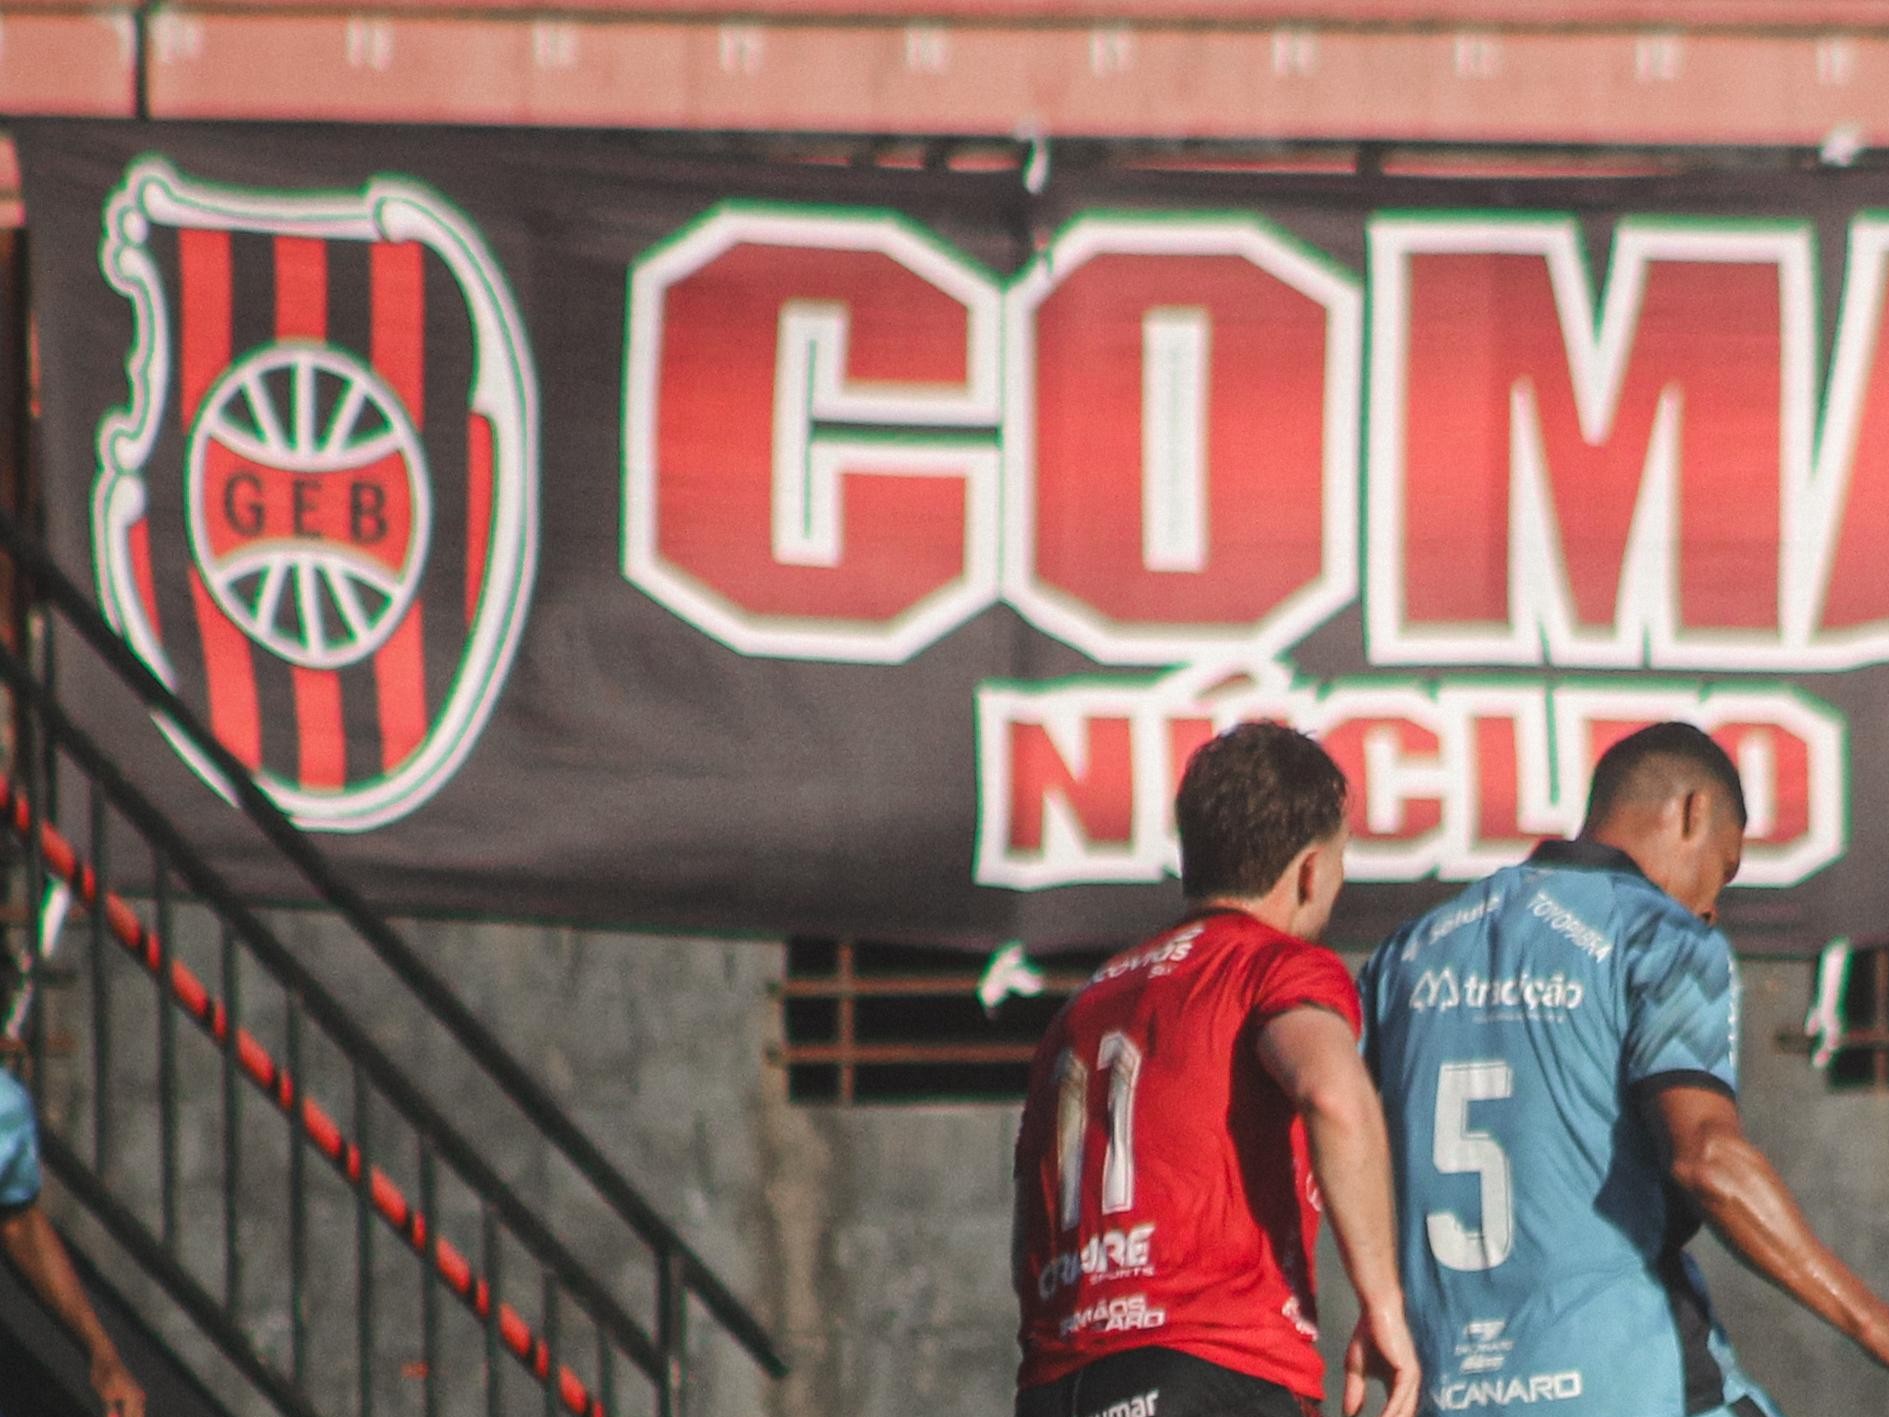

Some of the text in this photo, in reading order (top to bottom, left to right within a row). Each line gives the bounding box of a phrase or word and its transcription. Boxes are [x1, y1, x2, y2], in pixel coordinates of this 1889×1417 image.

[976, 660, 1850, 888] NCLO
[1053, 1030, 1142, 1231] 11
[1427, 1059, 1515, 1273] 5
